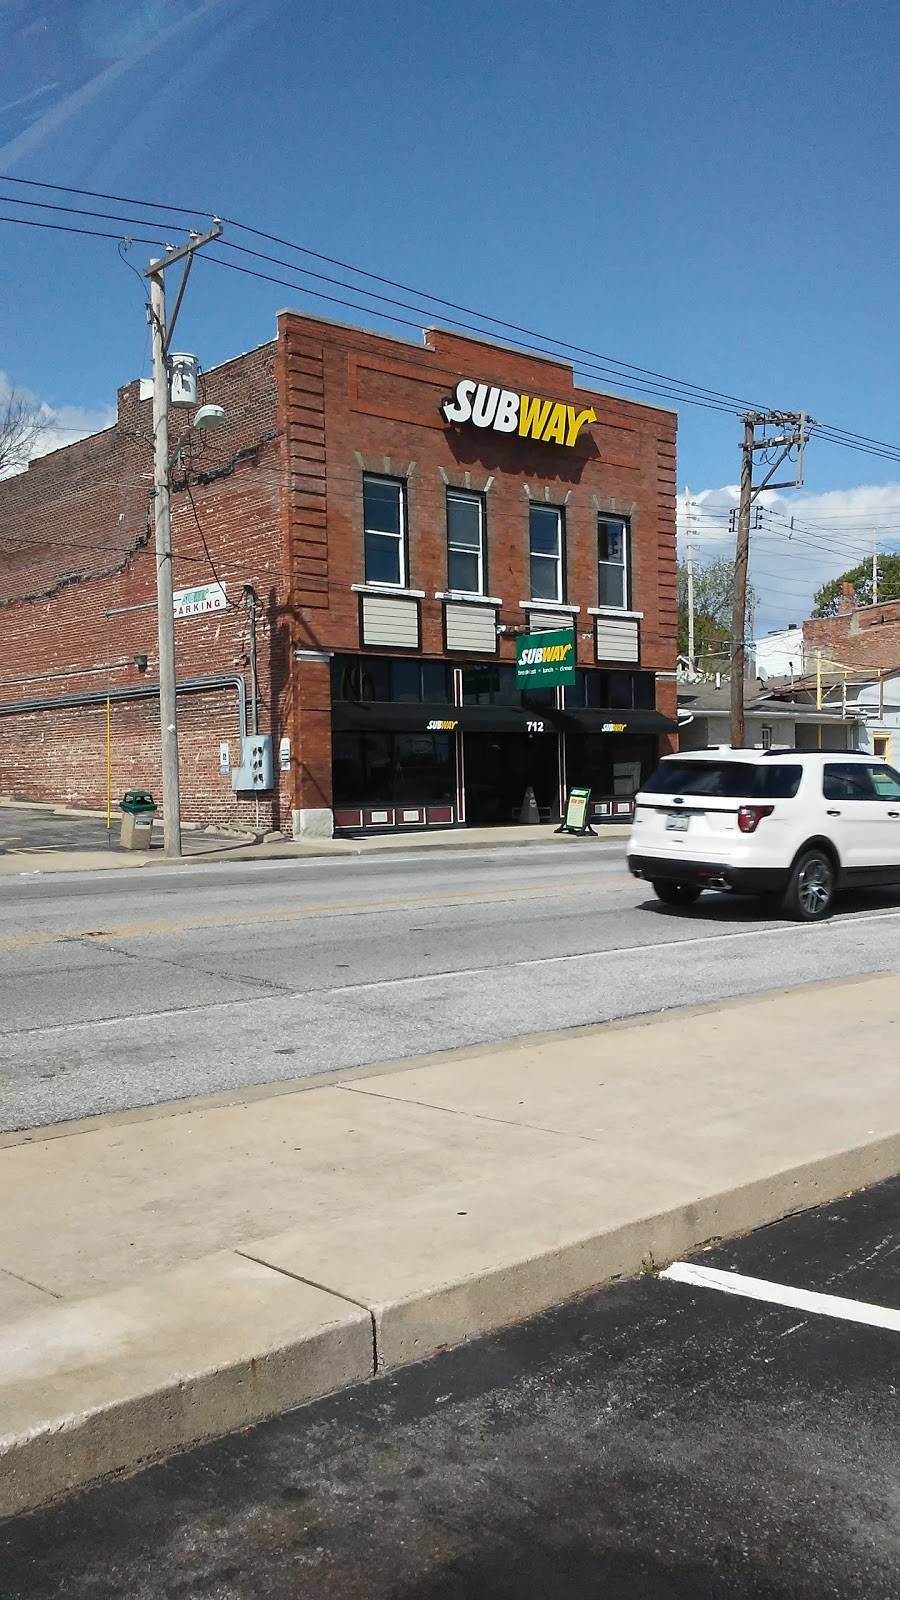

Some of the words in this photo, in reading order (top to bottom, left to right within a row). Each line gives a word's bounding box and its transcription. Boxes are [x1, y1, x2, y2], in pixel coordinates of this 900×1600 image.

[443, 380, 597, 447] SUBWAY
[518, 643, 573, 666] SUBWAY
[426, 720, 458, 730] SUBWAY
[526, 721, 544, 732] 712
